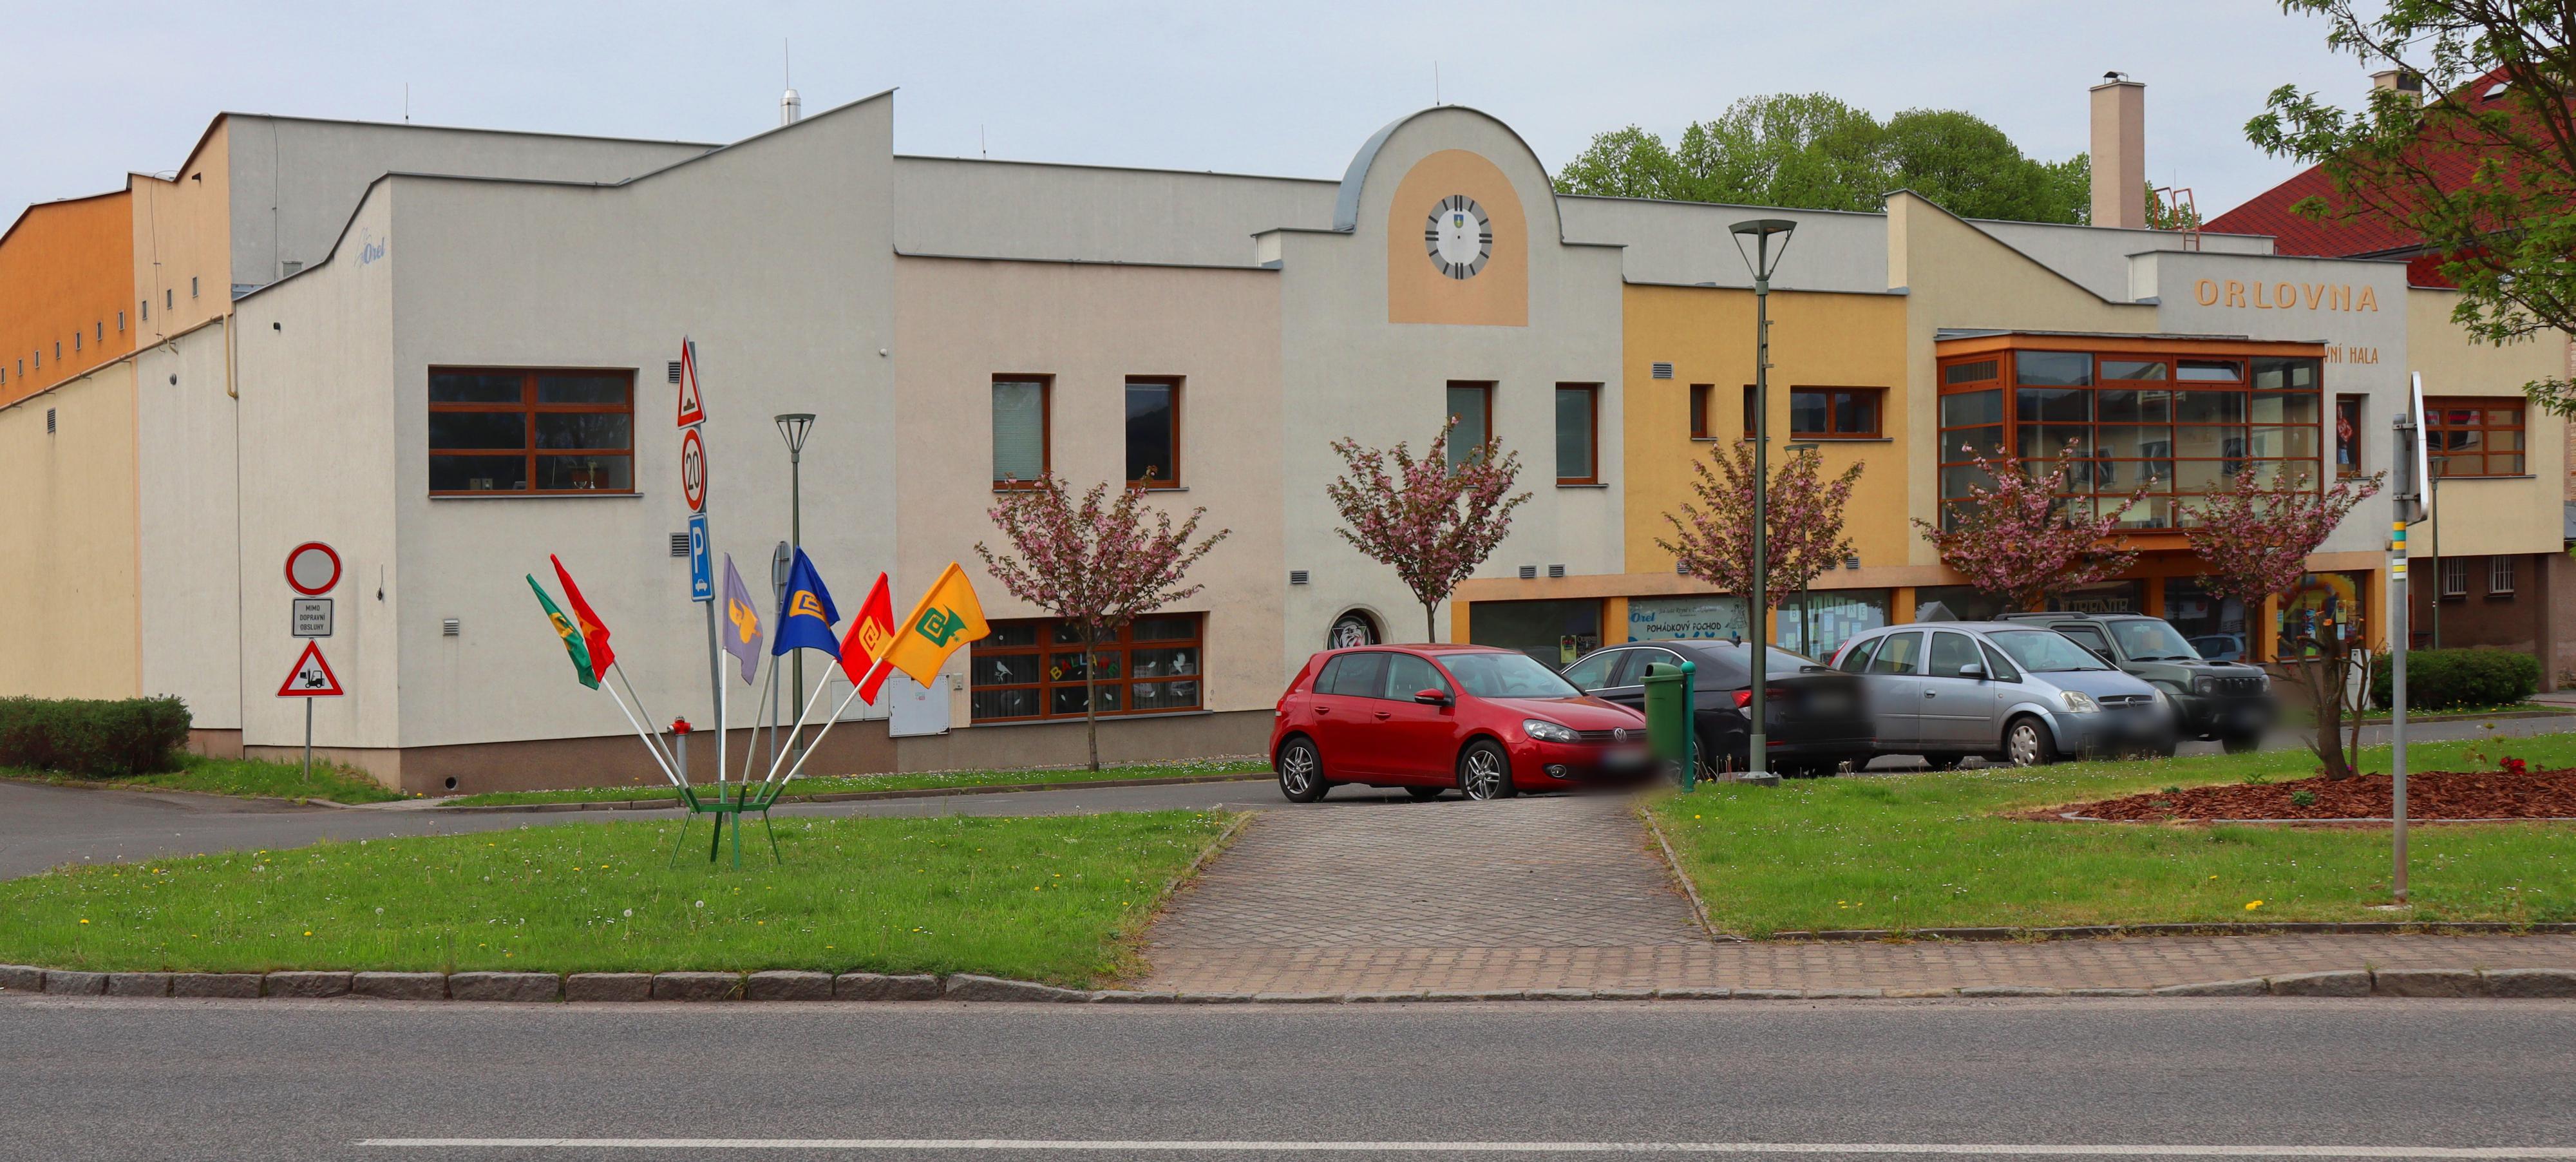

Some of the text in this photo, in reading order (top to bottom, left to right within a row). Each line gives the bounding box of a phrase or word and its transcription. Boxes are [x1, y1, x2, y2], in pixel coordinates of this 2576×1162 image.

[363, 237, 385, 264] Orel
[2194, 278, 2378, 311] ORLOVNA
[2349, 347, 2378, 364] HALA
[686, 450, 700, 491] 20
[692, 527, 704, 574] P
[1631, 613, 1656, 623] Orel
[1647, 621, 1721, 633] POHÁDKOVÝ POCHOD
